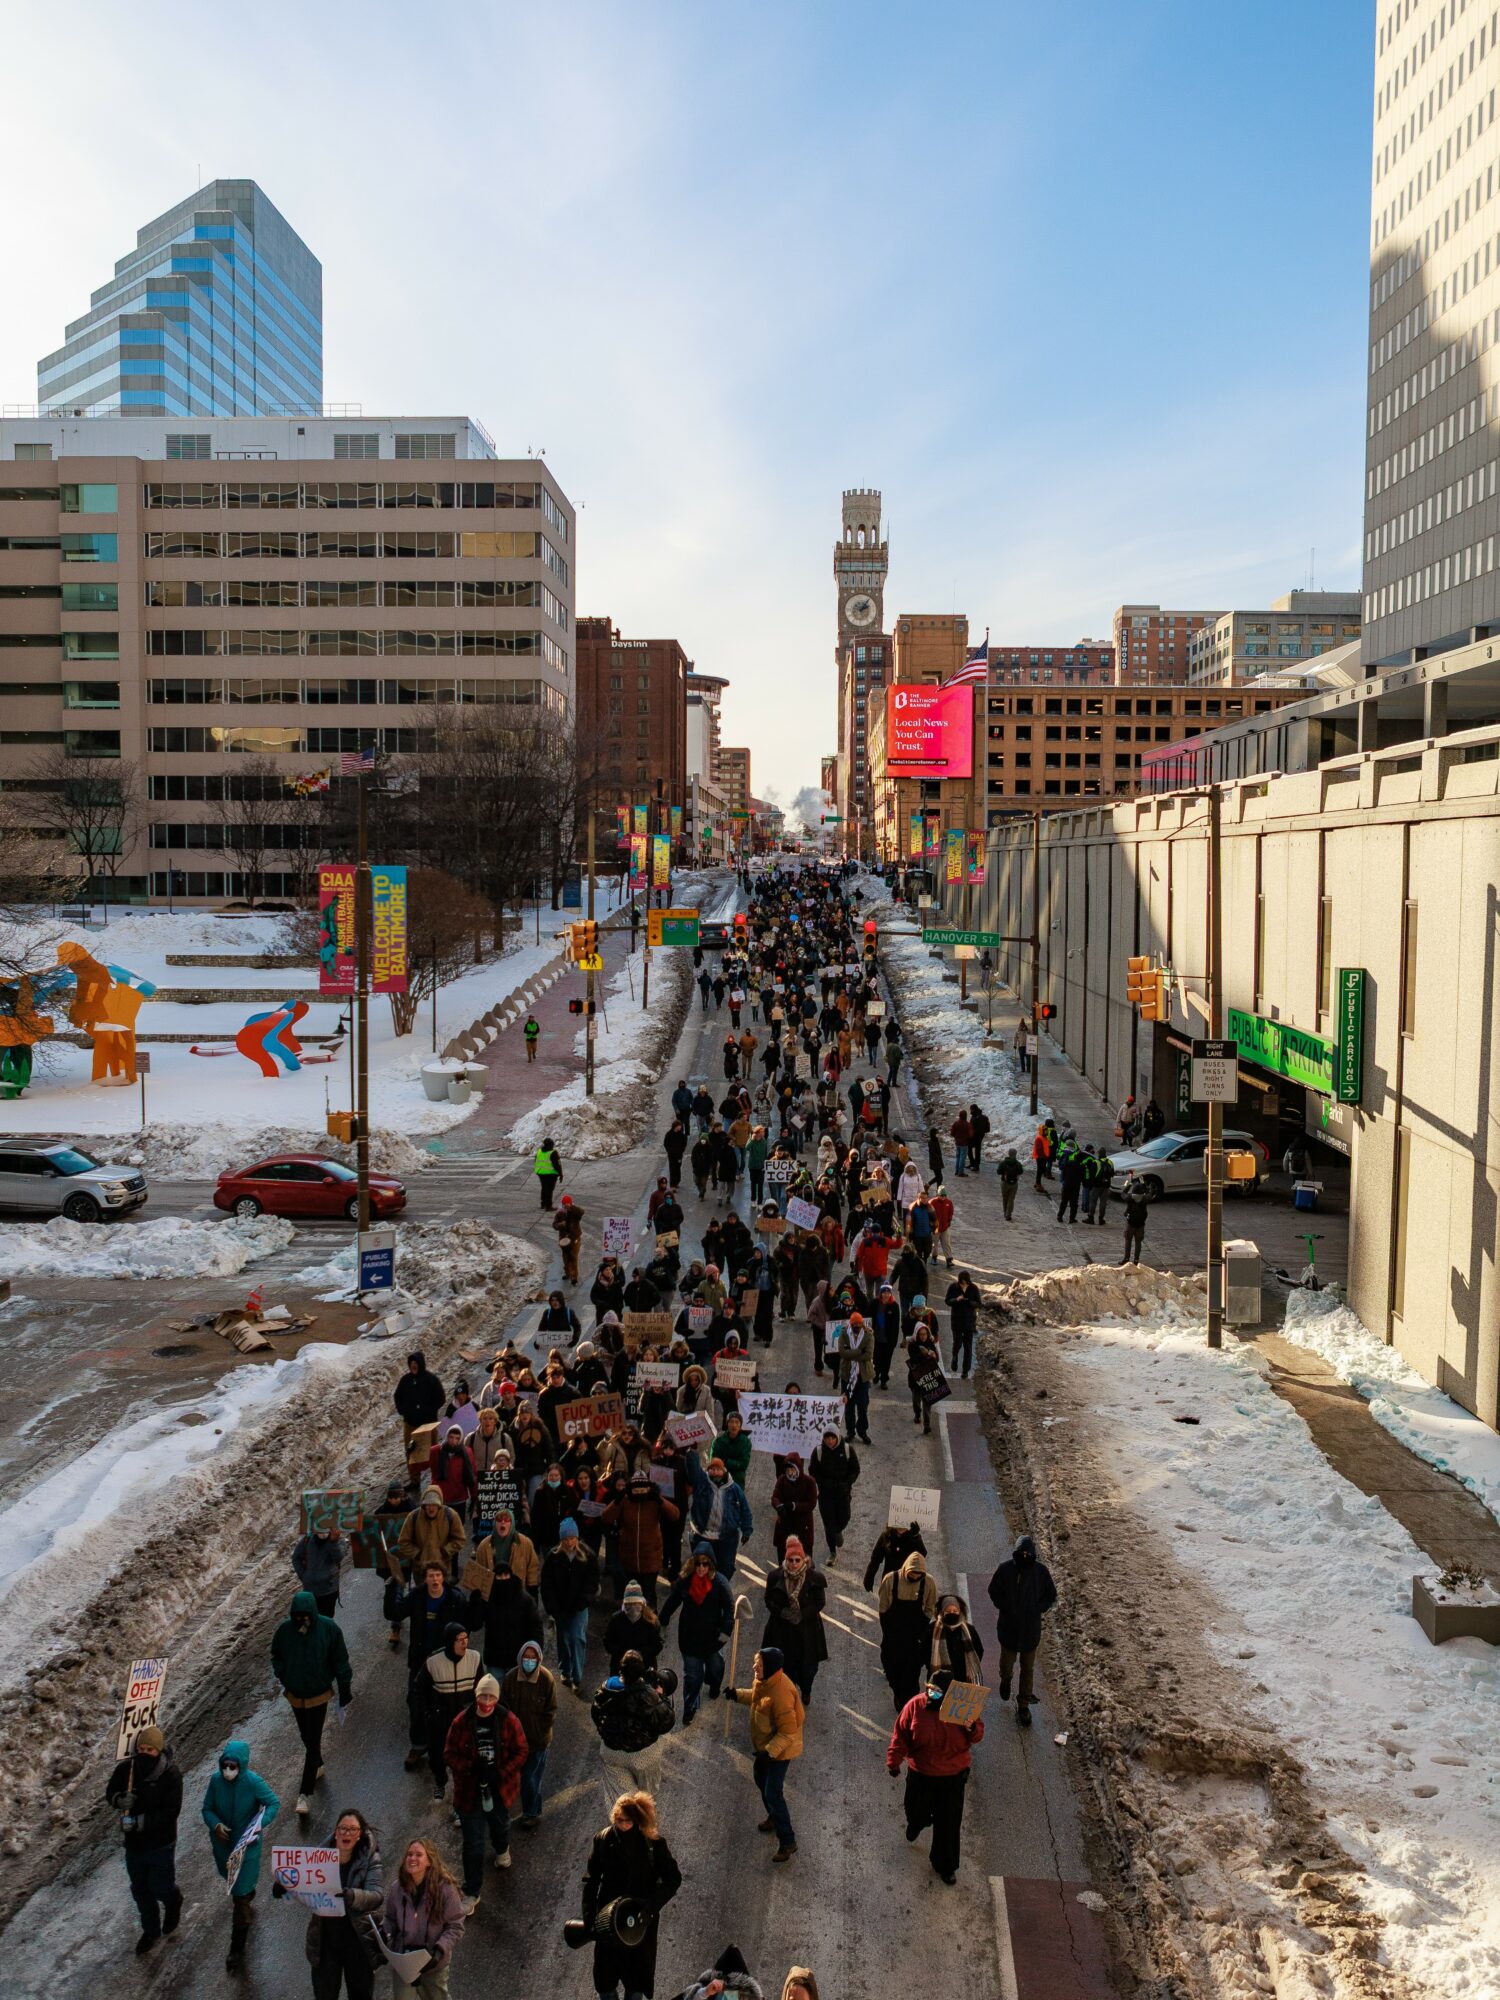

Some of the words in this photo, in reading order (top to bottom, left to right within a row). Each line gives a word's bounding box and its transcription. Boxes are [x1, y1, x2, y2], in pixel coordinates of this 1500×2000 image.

[611, 640, 632, 648] Days
[895, 718, 921, 727] Local
[923, 719, 948, 727] News
[895, 730, 913, 739] You
[914, 730, 934, 739] Can
[895, 742, 923, 751] Trust.
[321, 873, 354, 887] CIAA
[374, 875, 390, 897] TO
[390, 883, 405, 976] BALTIMORE
[374, 901, 390, 983] WELCOME
[925, 932, 977, 944] HANOVER
[981, 936, 995, 944] ST.
[1347, 992, 1355, 1032] PUBLIC
[1231, 1014, 1269, 1056] PUBLIC
[1272, 1030, 1333, 1081] PARKING
[1346, 1036, 1355, 1081] PARKING
[1179, 1053, 1191, 1113] PARK
[765, 1161, 795, 1170] FUCK
[767, 1171, 793, 1181] ICE
[365, 1253, 388, 1261] PUBLIC
[363, 1260, 390, 1268] PARKING
[539, 1333, 561, 1342] THIS
[923, 1380, 939, 1391] THIS
[562, 1403, 592, 1420] FUCK
[564, 1418, 590, 1436] GET
[593, 1413, 622, 1430] OUT!
[484, 1471, 509, 1480] ICE
[478, 1482, 497, 1490] hasn't
[478, 1493, 495, 1501] their
[496, 1492, 519, 1501] DICKS
[903, 1488, 927, 1501] ICE
[914, 1504, 933, 1516] Under
[132, 1660, 165, 1680] HANDS
[130, 1679, 160, 1699] OFF!
[122, 1700, 158, 1735] FUCK
[948, 1701, 978, 1721] ICE
[273, 1851, 302, 1867] THE
[304, 1850, 339, 1865] WRONG
[276, 1869, 298, 1885] ICE
[305, 1870, 326, 1884] IS
